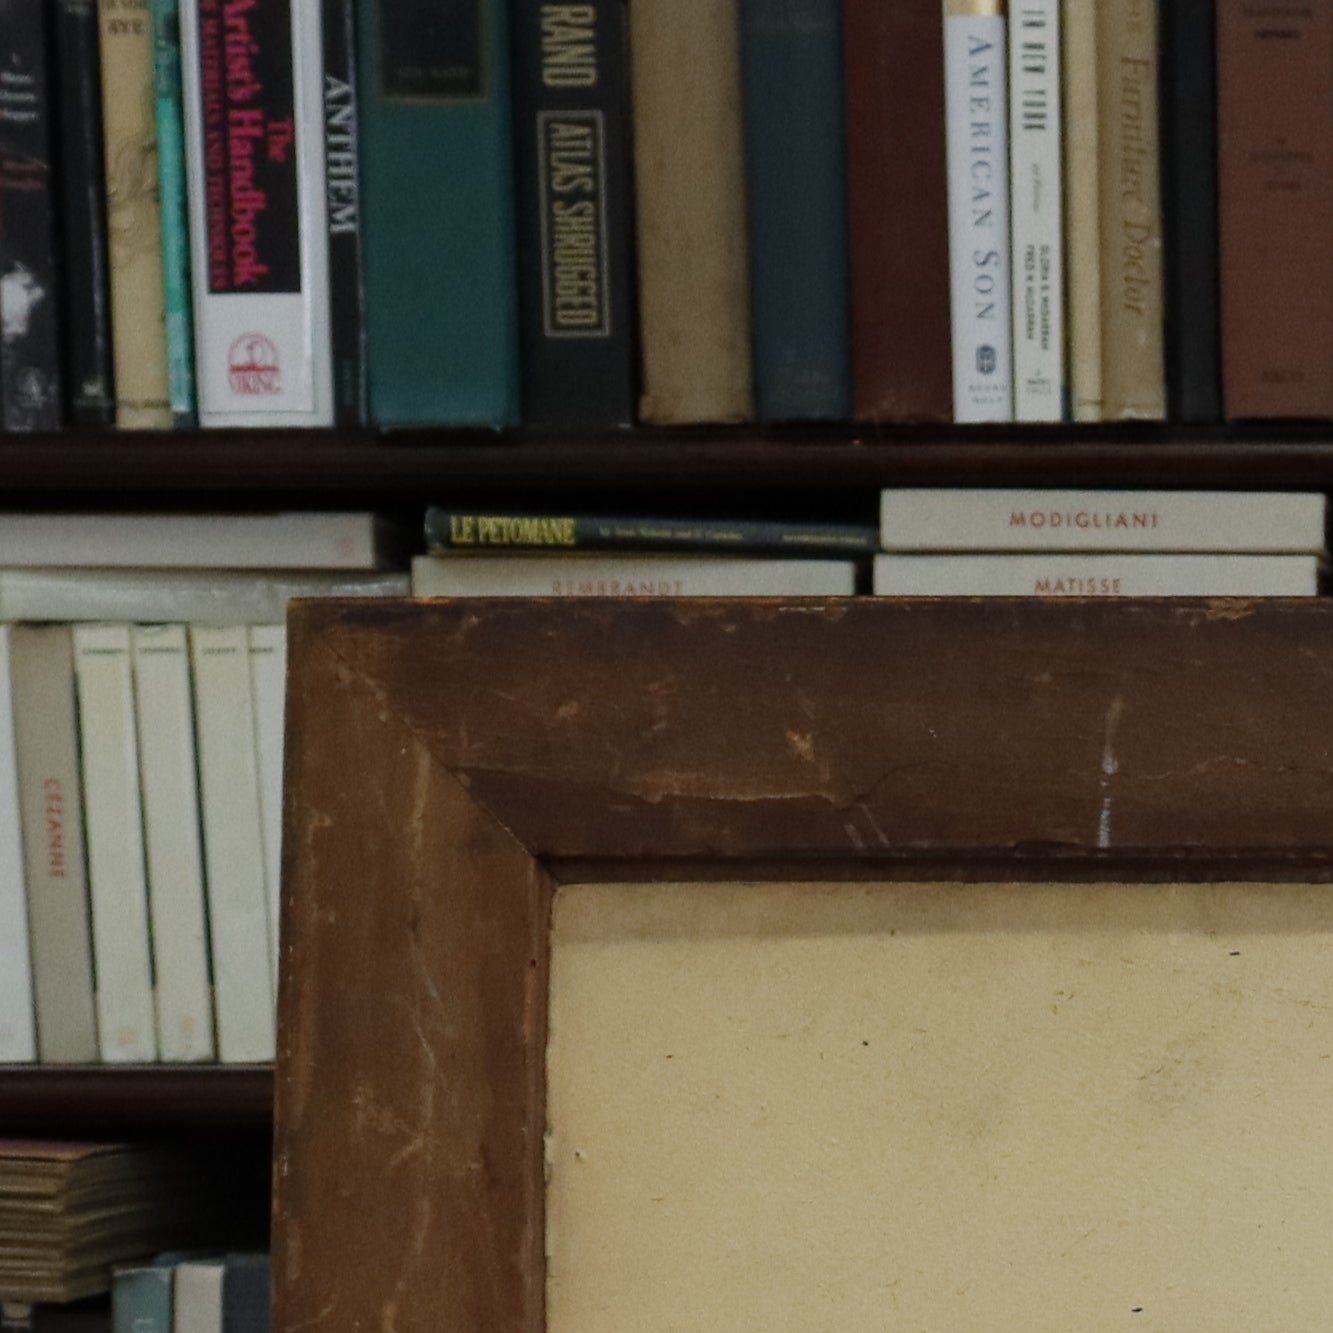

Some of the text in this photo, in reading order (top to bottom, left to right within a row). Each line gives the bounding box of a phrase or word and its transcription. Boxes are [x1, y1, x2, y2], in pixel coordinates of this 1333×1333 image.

[541, 6, 597, 87] RAND
[267, 119, 296, 162] The
[324, 75, 358, 234] ANTHEM
[230, 110, 271, 287] Handbook
[967, 35, 1001, 321] AMERICAN SON
[549, 123, 598, 325] ATLAS SHRUGGED
[1024, 245, 1035, 271] FRED
[1123, 220, 1154, 317] Doctor
[451, 516, 576, 547] LE PETOMANE
[1008, 510, 1160, 530] MODIGLIANI
[551, 579, 685, 596] REMBRANDT
[1033, 577, 1122, 596] MATISSE
